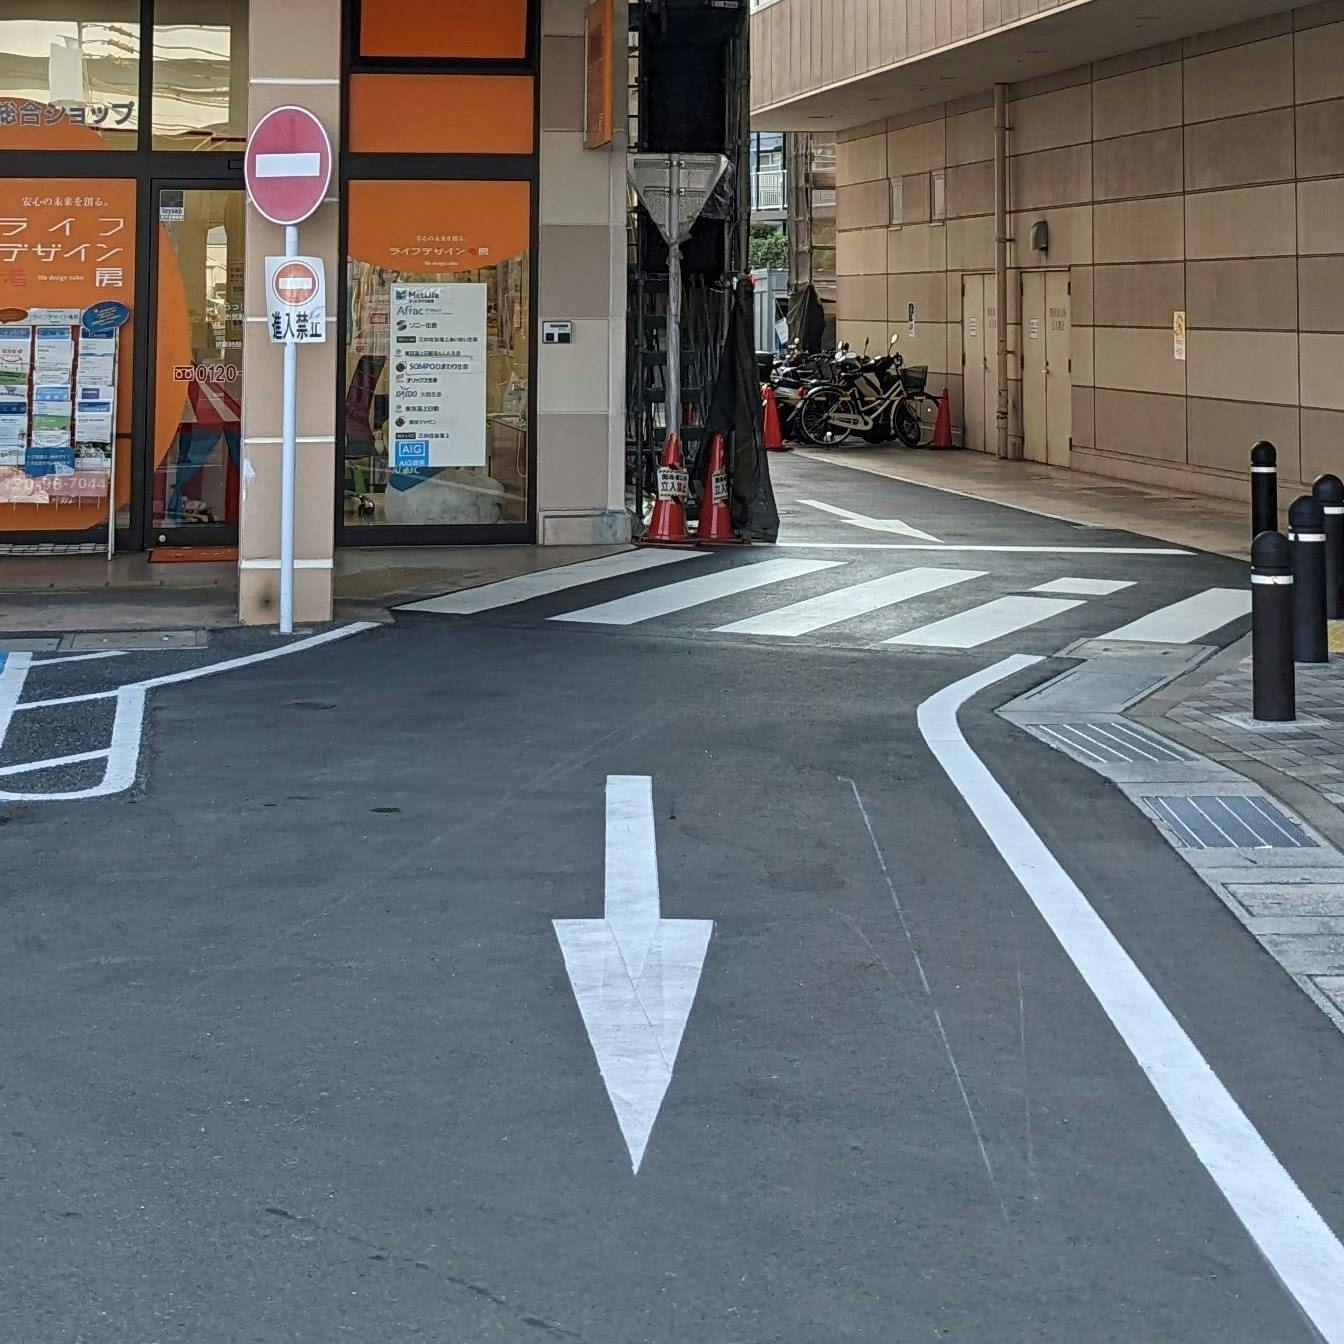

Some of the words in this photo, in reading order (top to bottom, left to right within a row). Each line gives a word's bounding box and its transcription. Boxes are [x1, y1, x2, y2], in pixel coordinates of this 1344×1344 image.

[408, 291, 440, 299] MetLife
[271, 311, 323, 340] 進入禁止
[401, 445, 423, 454] AIG
